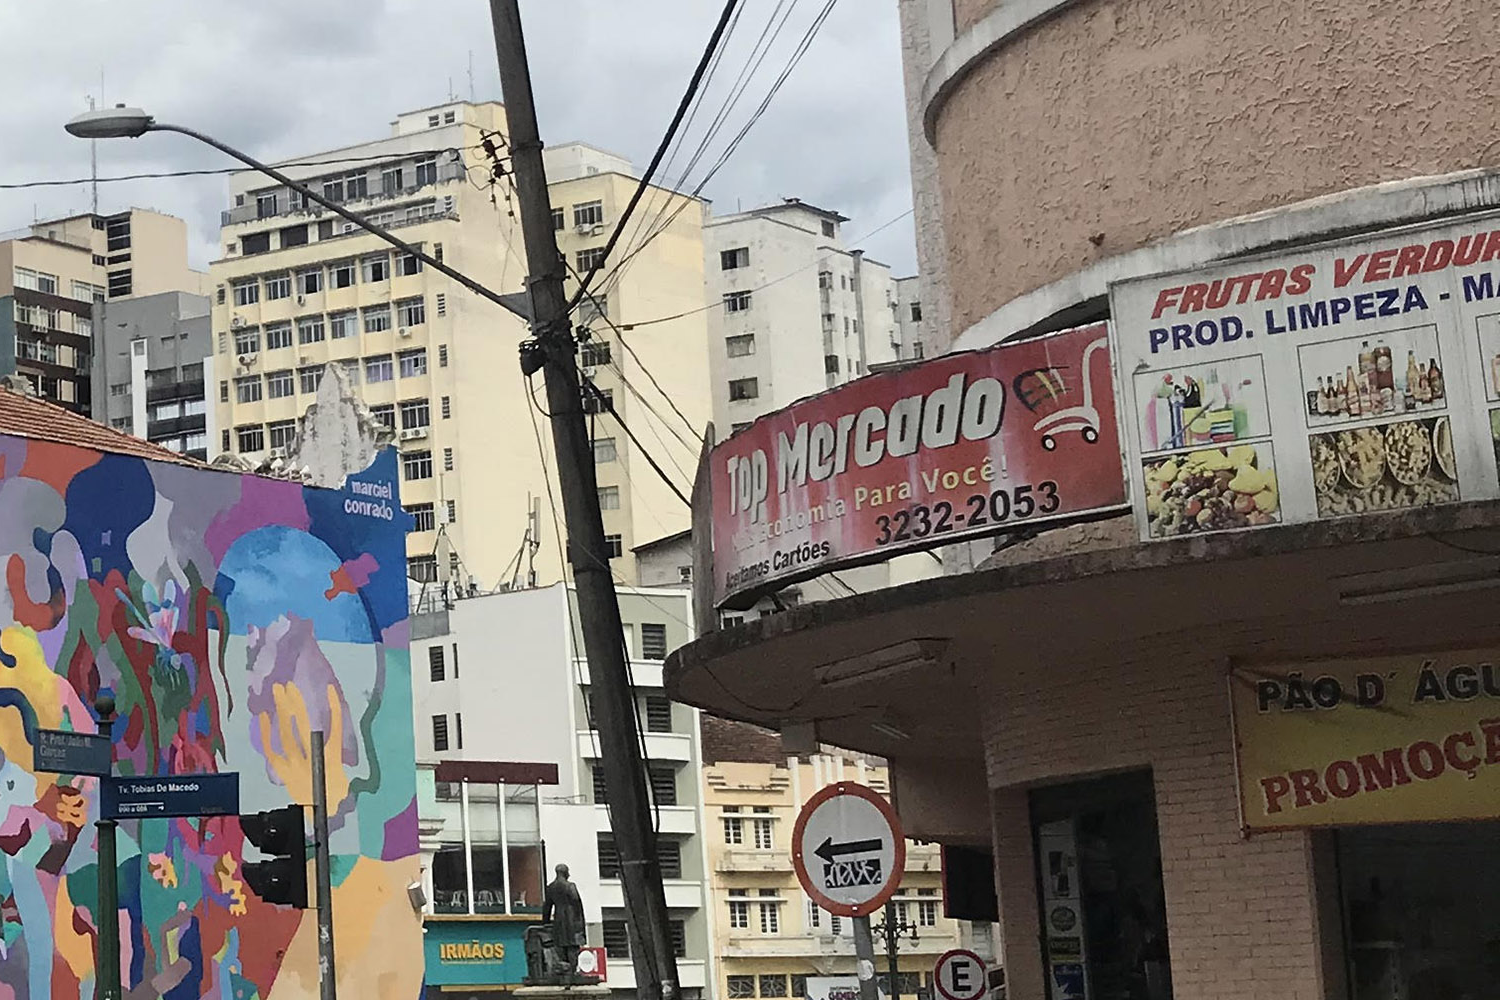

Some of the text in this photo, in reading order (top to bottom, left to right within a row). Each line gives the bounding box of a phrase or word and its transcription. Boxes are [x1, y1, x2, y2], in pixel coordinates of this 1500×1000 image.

[1151, 265, 1317, 319] FRUTAS
[1149, 315, 1254, 353] PROD.
[1265, 285, 1429, 336] LIMPEZA
[726, 372, 1006, 524] Top Mercado
[351, 480, 392, 500] marciel
[854, 481, 912, 511] Para
[344, 499, 394, 521] conrado
[875, 481, 1061, 546] 3232-2053
[773, 540, 831, 571] Cartões
[1257, 670, 1342, 713] PÃO
[118, 782, 199, 794] Tv. Tobias De Macedo
[440, 939, 505, 959] IRMÃOS
[951, 961, 972, 992] E
